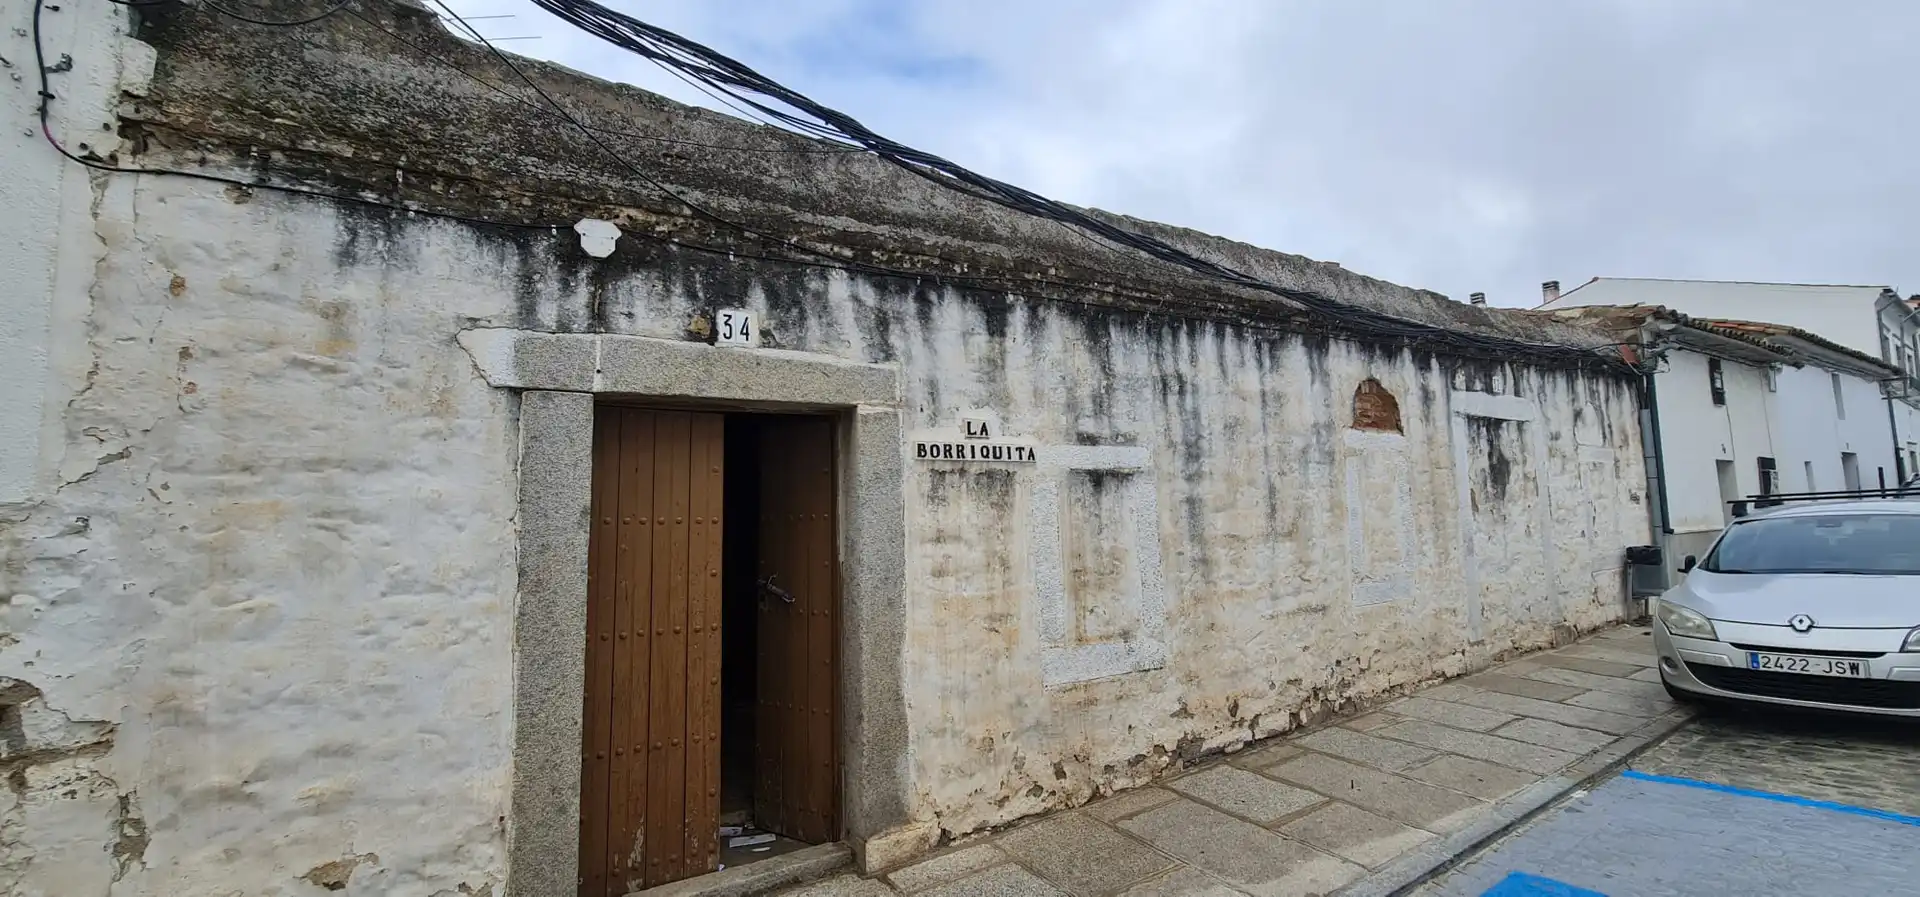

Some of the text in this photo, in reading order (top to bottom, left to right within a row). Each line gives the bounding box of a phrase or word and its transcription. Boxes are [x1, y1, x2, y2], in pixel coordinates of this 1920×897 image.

[722, 313, 750, 341] 34
[966, 421, 989, 436] LA
[916, 443, 1036, 461] BORRIQUITA
